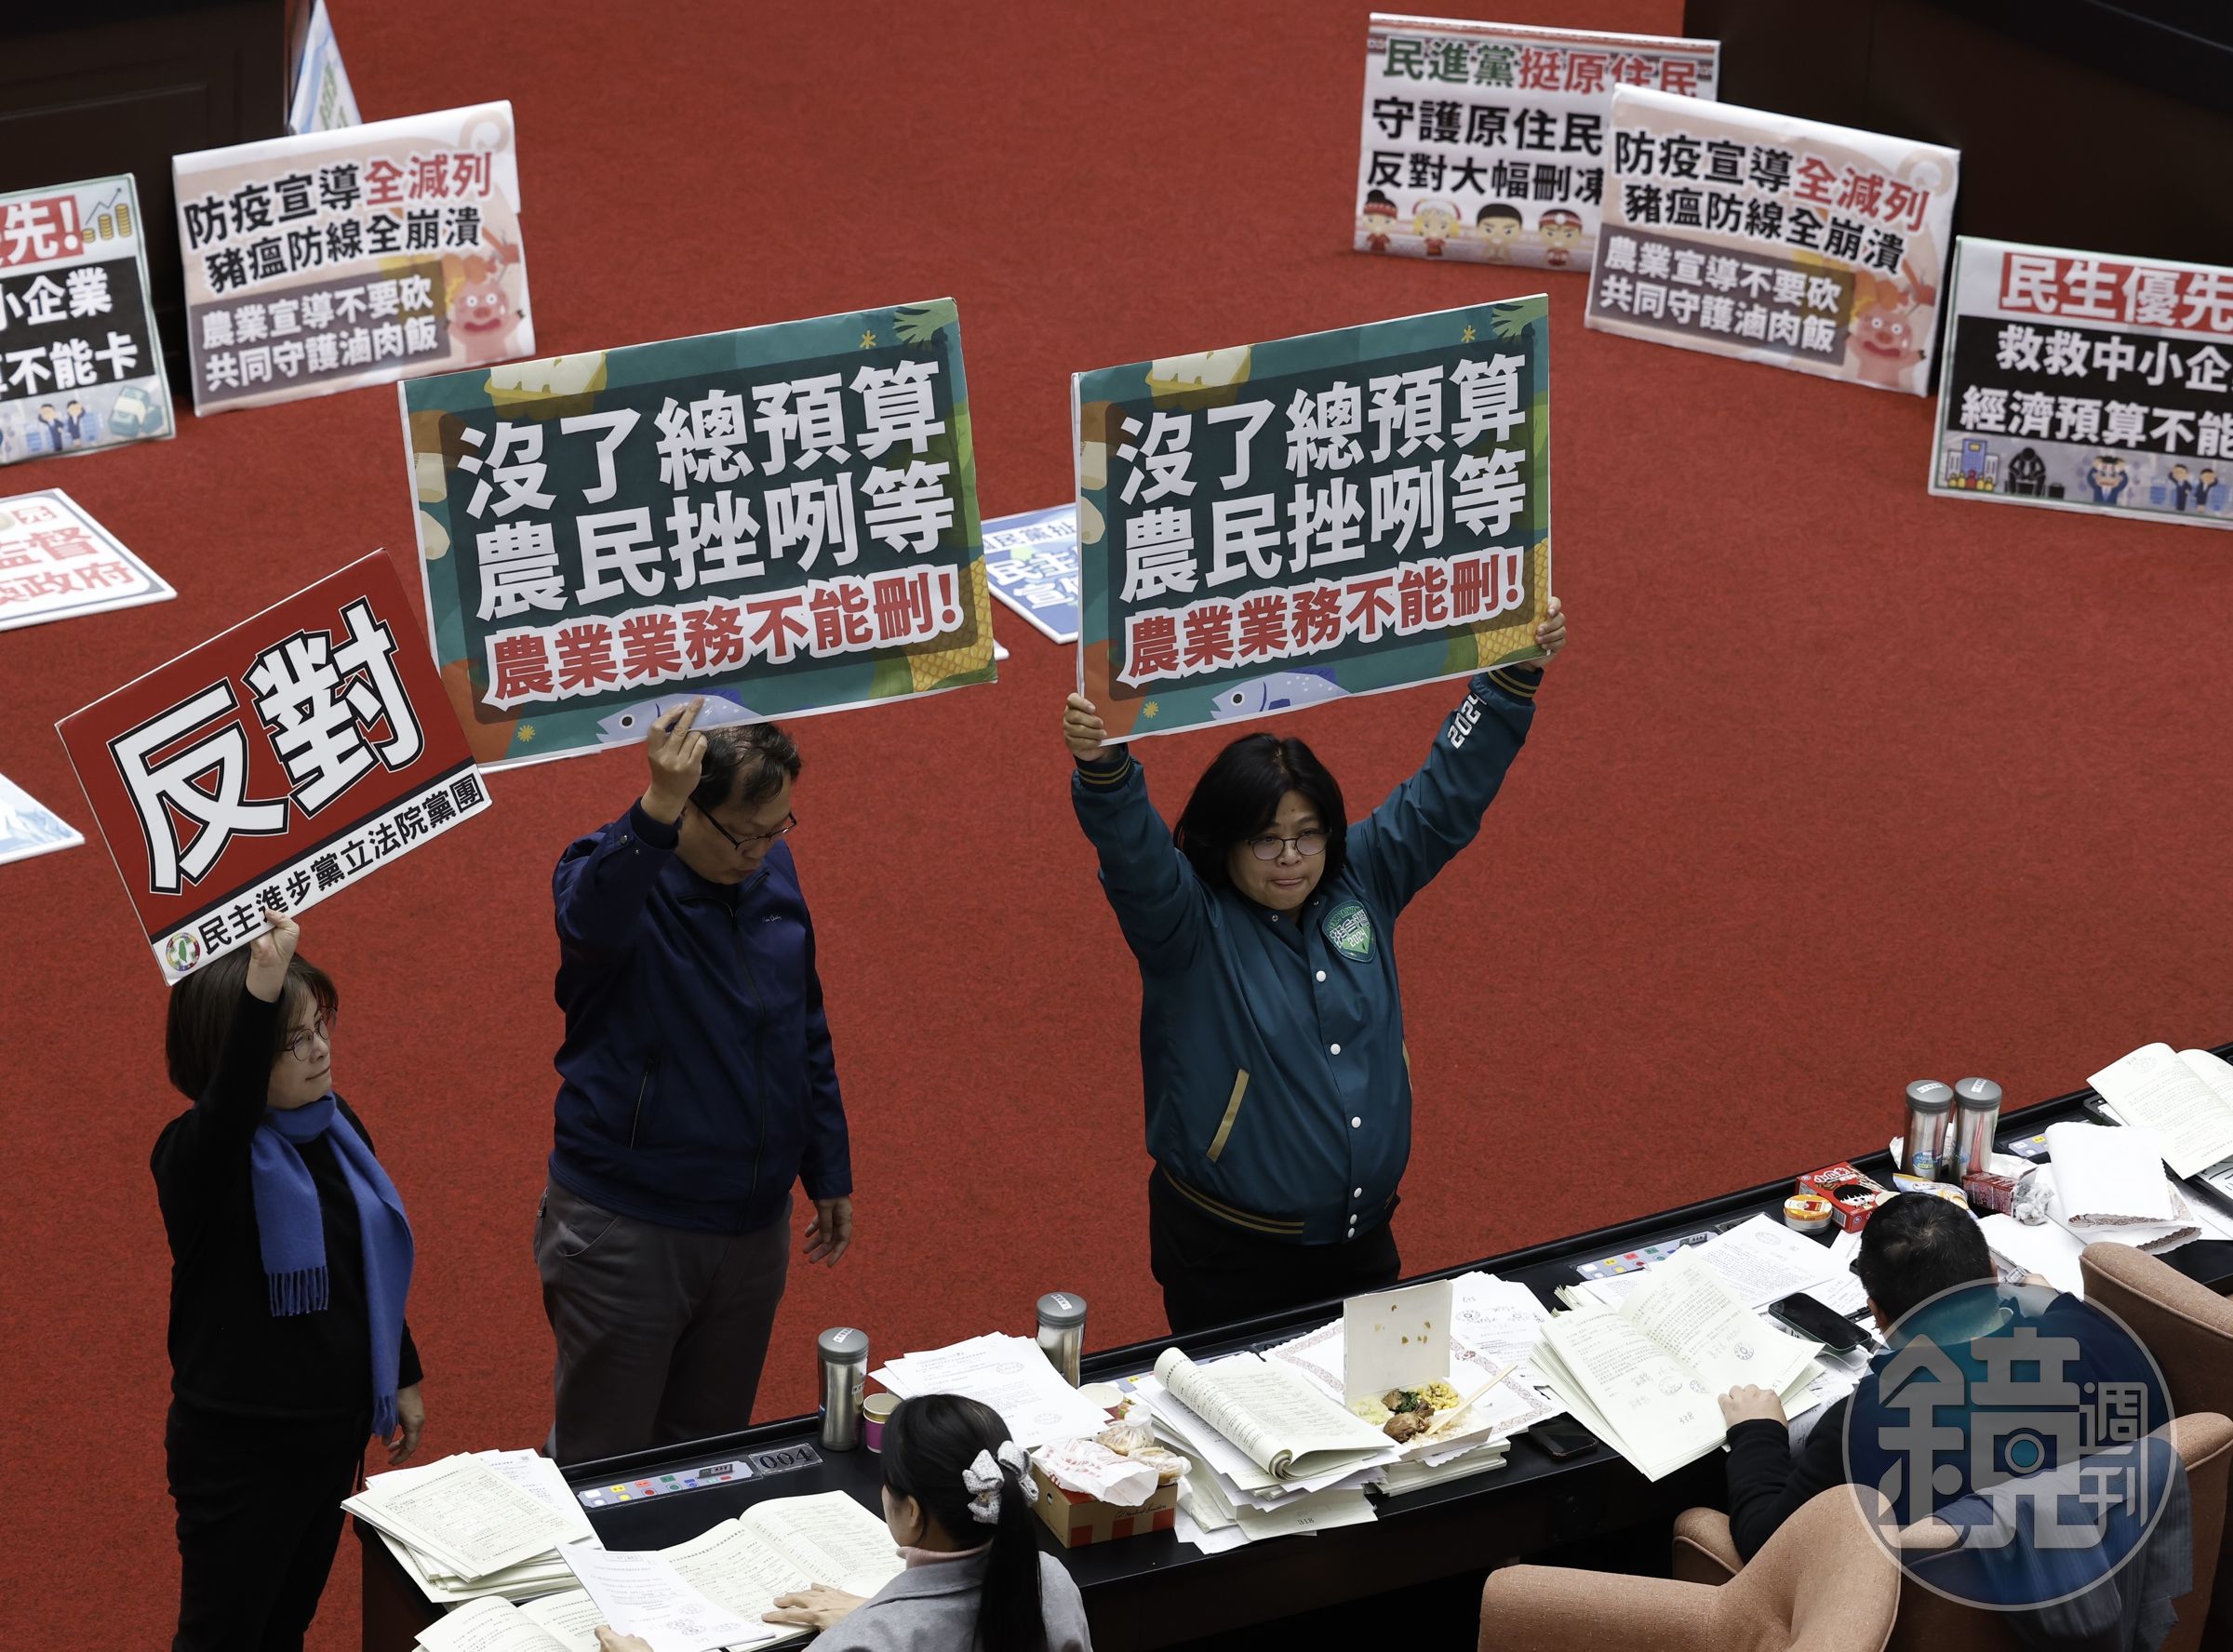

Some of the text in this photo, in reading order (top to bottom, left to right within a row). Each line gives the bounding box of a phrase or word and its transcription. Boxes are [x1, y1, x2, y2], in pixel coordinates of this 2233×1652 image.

[1383, 38, 1697, 97] 民進黨挺原住民
[1373, 97, 1602, 156] 守護原住民
[185, 152, 491, 248] 防疫宣導全減列
[1614, 131, 1930, 233] 防疫宣導全減列
[0, 200, 79, 265] 先!
[206, 209, 480, 293] 豬瘟防線全崩潰
[1625, 183, 1904, 275] 豬瘟防線全崩潰
[202, 275, 434, 351] 農業宣導不要砍
[1604, 235, 1842, 314] 農業宣導不要砍
[2001, 254, 2233, 331] 民生優先
[205, 316, 438, 392] 共同守護滷肉飯
[1600, 278, 1837, 353] 共同守護滷肉飯
[0, 331, 138, 395] 不能卡
[1996, 325, 2233, 394] 救救中小企
[457, 360, 945, 519] 沒了總預算
[1116, 353, 1526, 504] 沒了總預算
[1959, 384, 2233, 460] 經濟預算不能
[476, 460, 955, 621] 農民挫咧等
[1119, 448, 1526, 603] 農民挫咧等
[490, 569, 959, 703] 農業業務不能刪!
[1127, 553, 1521, 681] 農業業務不能刪!
[106, 596, 425, 896] 反對
[1448, 693, 1487, 749] 2024
[199, 772, 486, 954] 民主進步黨立法院黨團
[1347, 928, 1369, 947] 2024
[759, 1447, 813, 1470] 004
